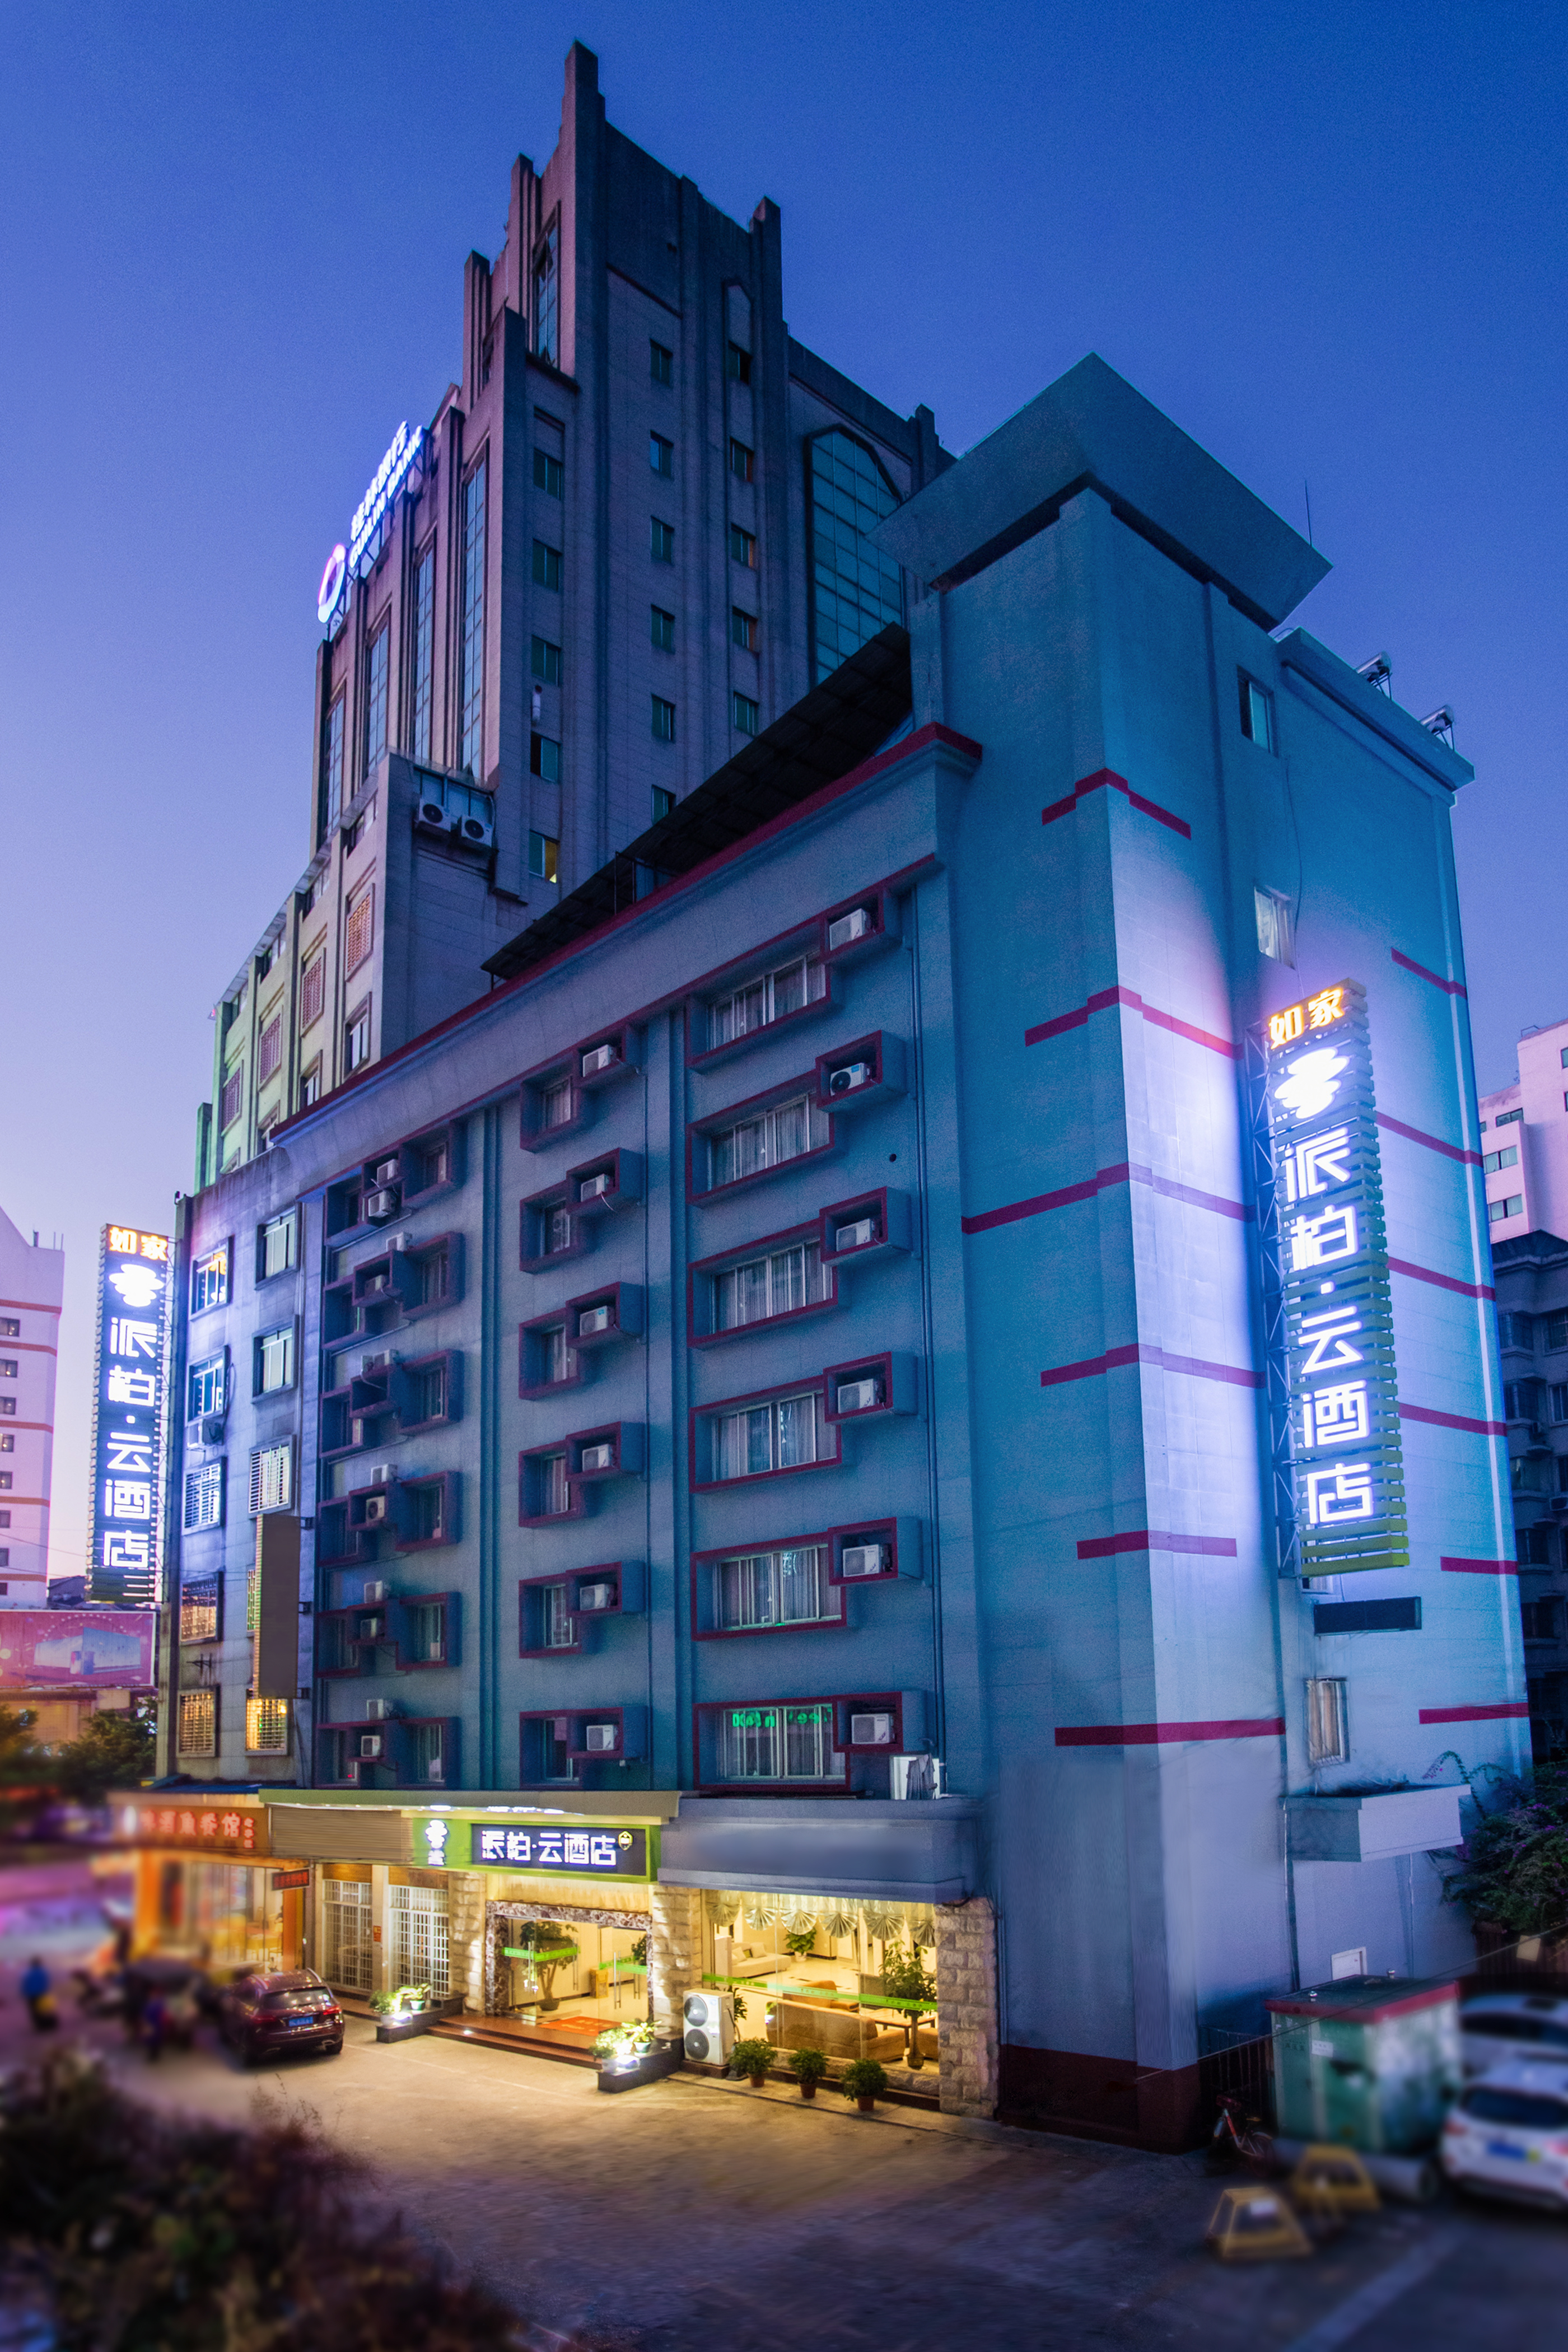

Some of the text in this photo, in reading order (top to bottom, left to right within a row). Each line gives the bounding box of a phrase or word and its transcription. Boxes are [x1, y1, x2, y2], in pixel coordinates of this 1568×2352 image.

[349, 425, 422, 568] GUILIN BANK
[1269, 988, 1345, 1049] 如家
[109, 1227, 168, 1261] 如家
